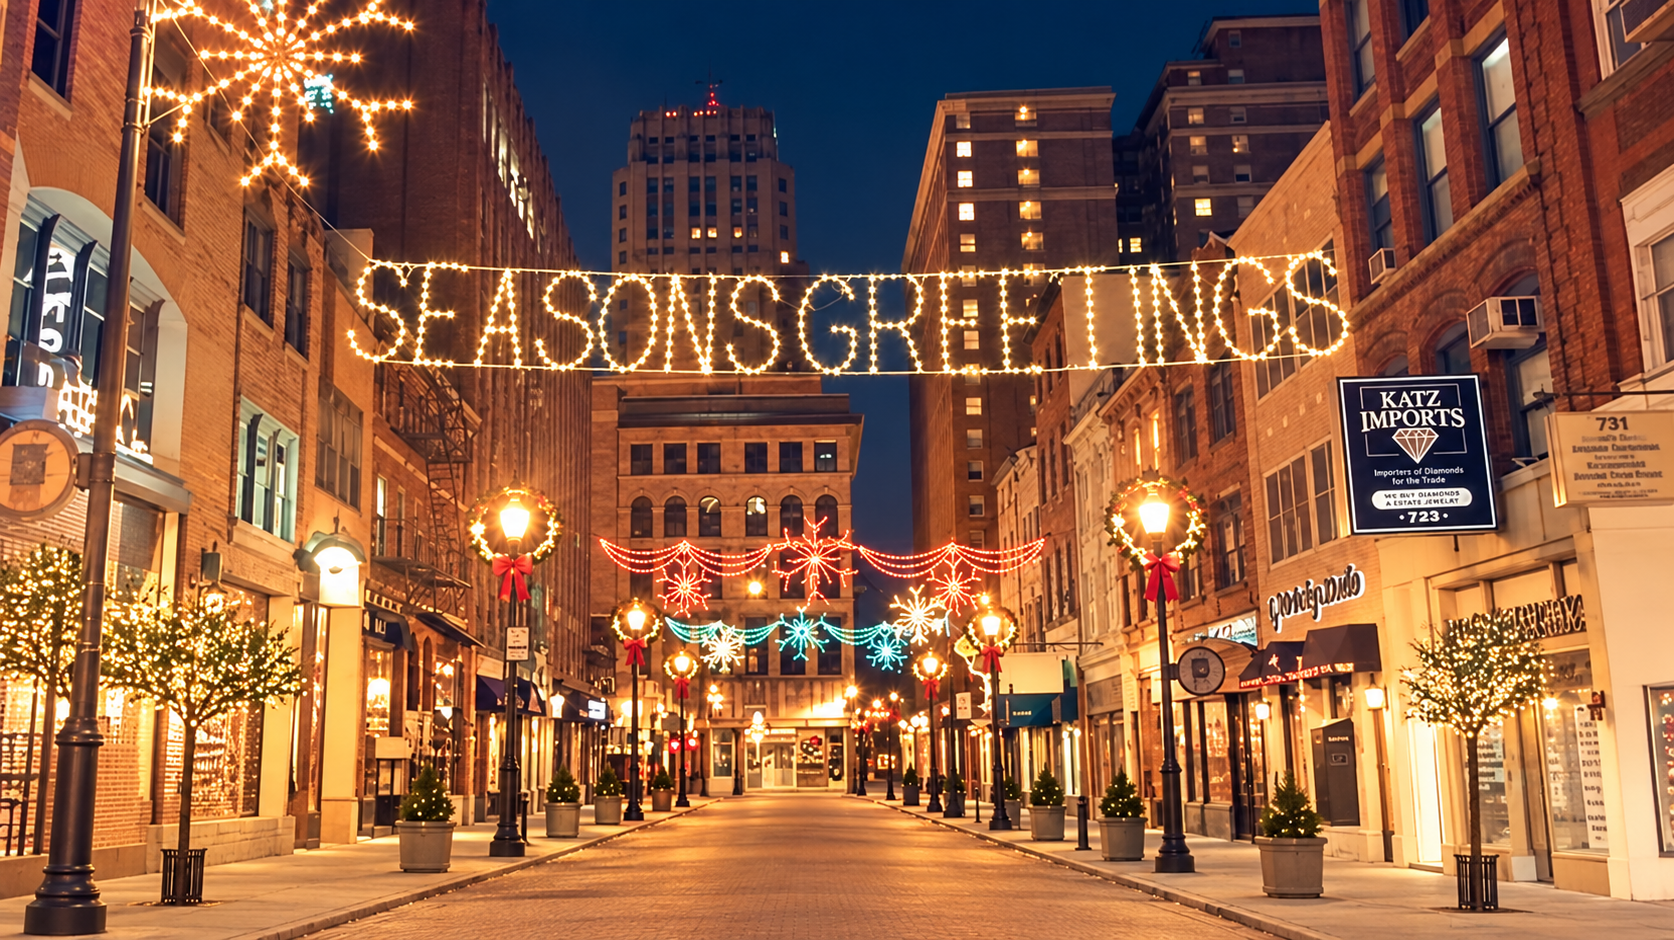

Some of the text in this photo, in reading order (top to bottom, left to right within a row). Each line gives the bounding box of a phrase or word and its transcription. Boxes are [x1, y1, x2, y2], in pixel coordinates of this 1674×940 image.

[347, 250, 1351, 376] SEASONS GREETINGS
[1380, 390, 1441, 408] KATZ
[1359, 408, 1465, 432] IMPORTS
[1595, 416, 1629, 431] 731
[1374, 468, 1412, 478] Importers
[1424, 466, 1464, 475] Diamonds
[1392, 476, 1446, 485] for the Trade
[1418, 490, 1460, 498] DIAMONDS
[1407, 510, 1441, 523] 723
